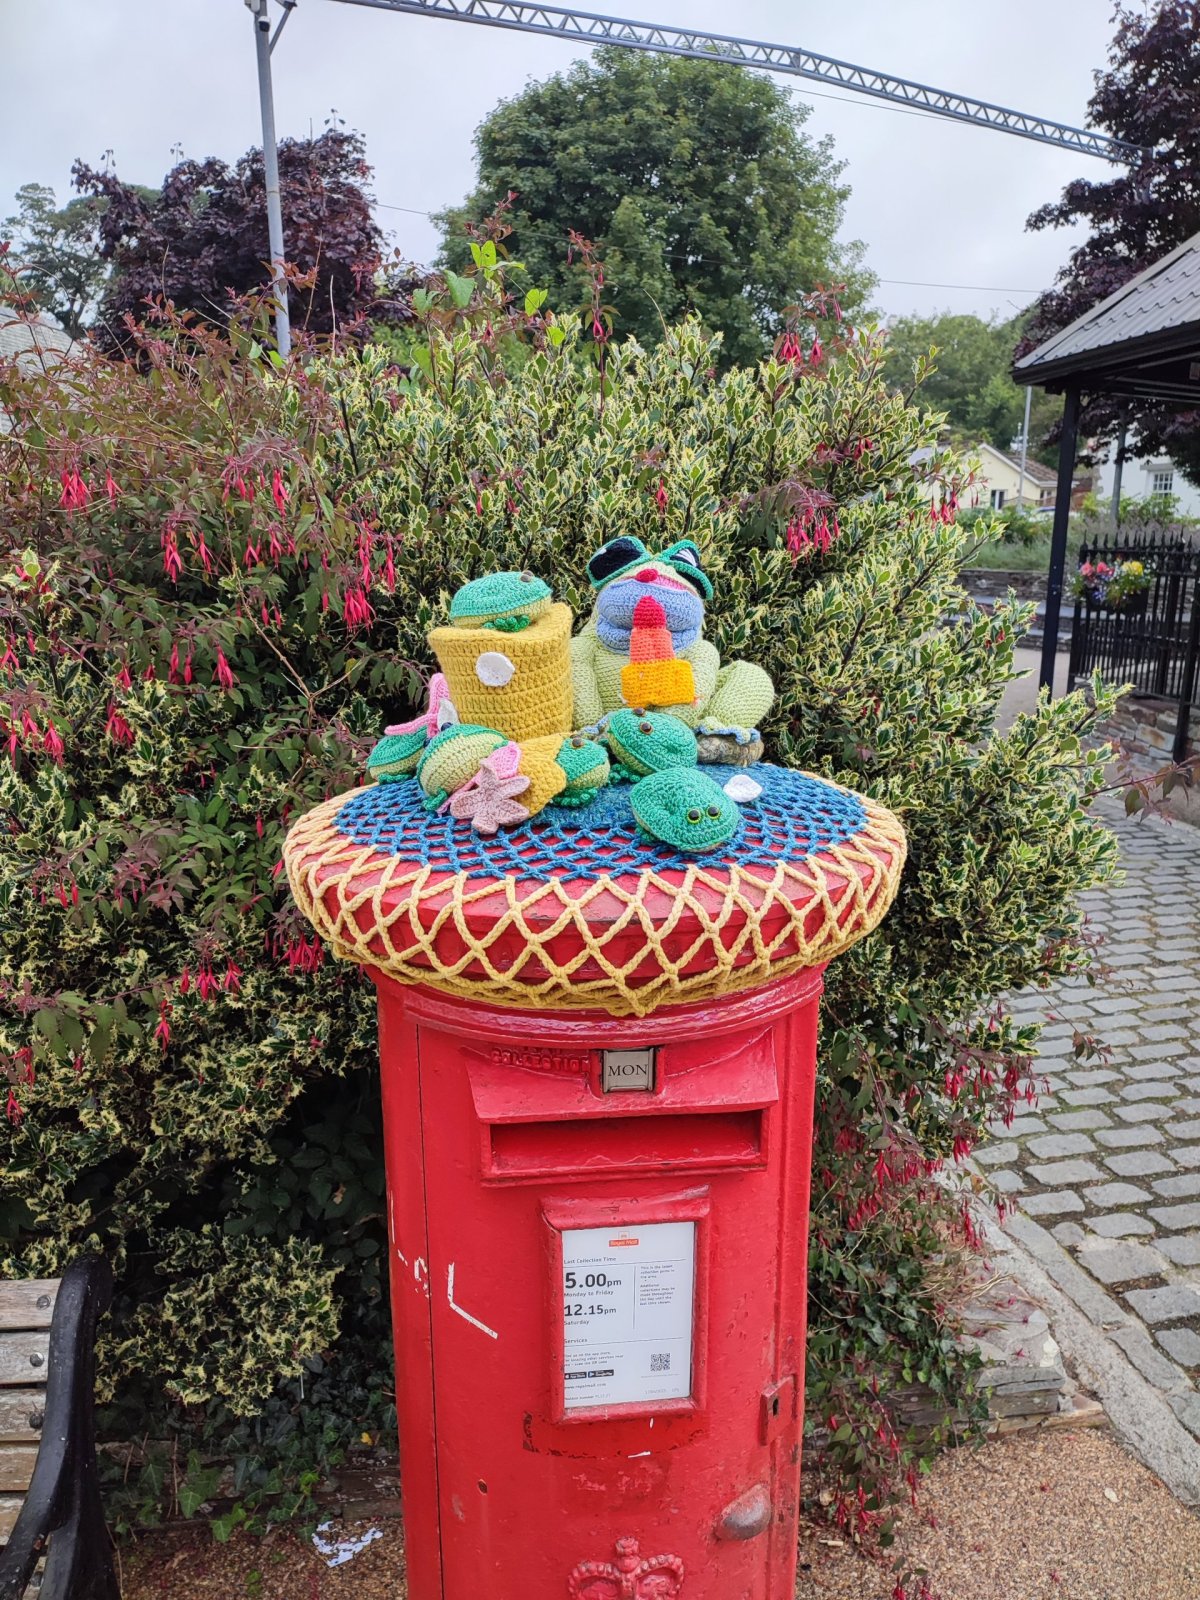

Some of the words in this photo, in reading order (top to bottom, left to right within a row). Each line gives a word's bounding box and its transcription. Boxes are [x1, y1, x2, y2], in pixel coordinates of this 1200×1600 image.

[608, 1064, 648, 1077] MON
[565, 1272, 622, 1289] 5.00pm
[564, 1304, 617, 1317] 12.15pm
